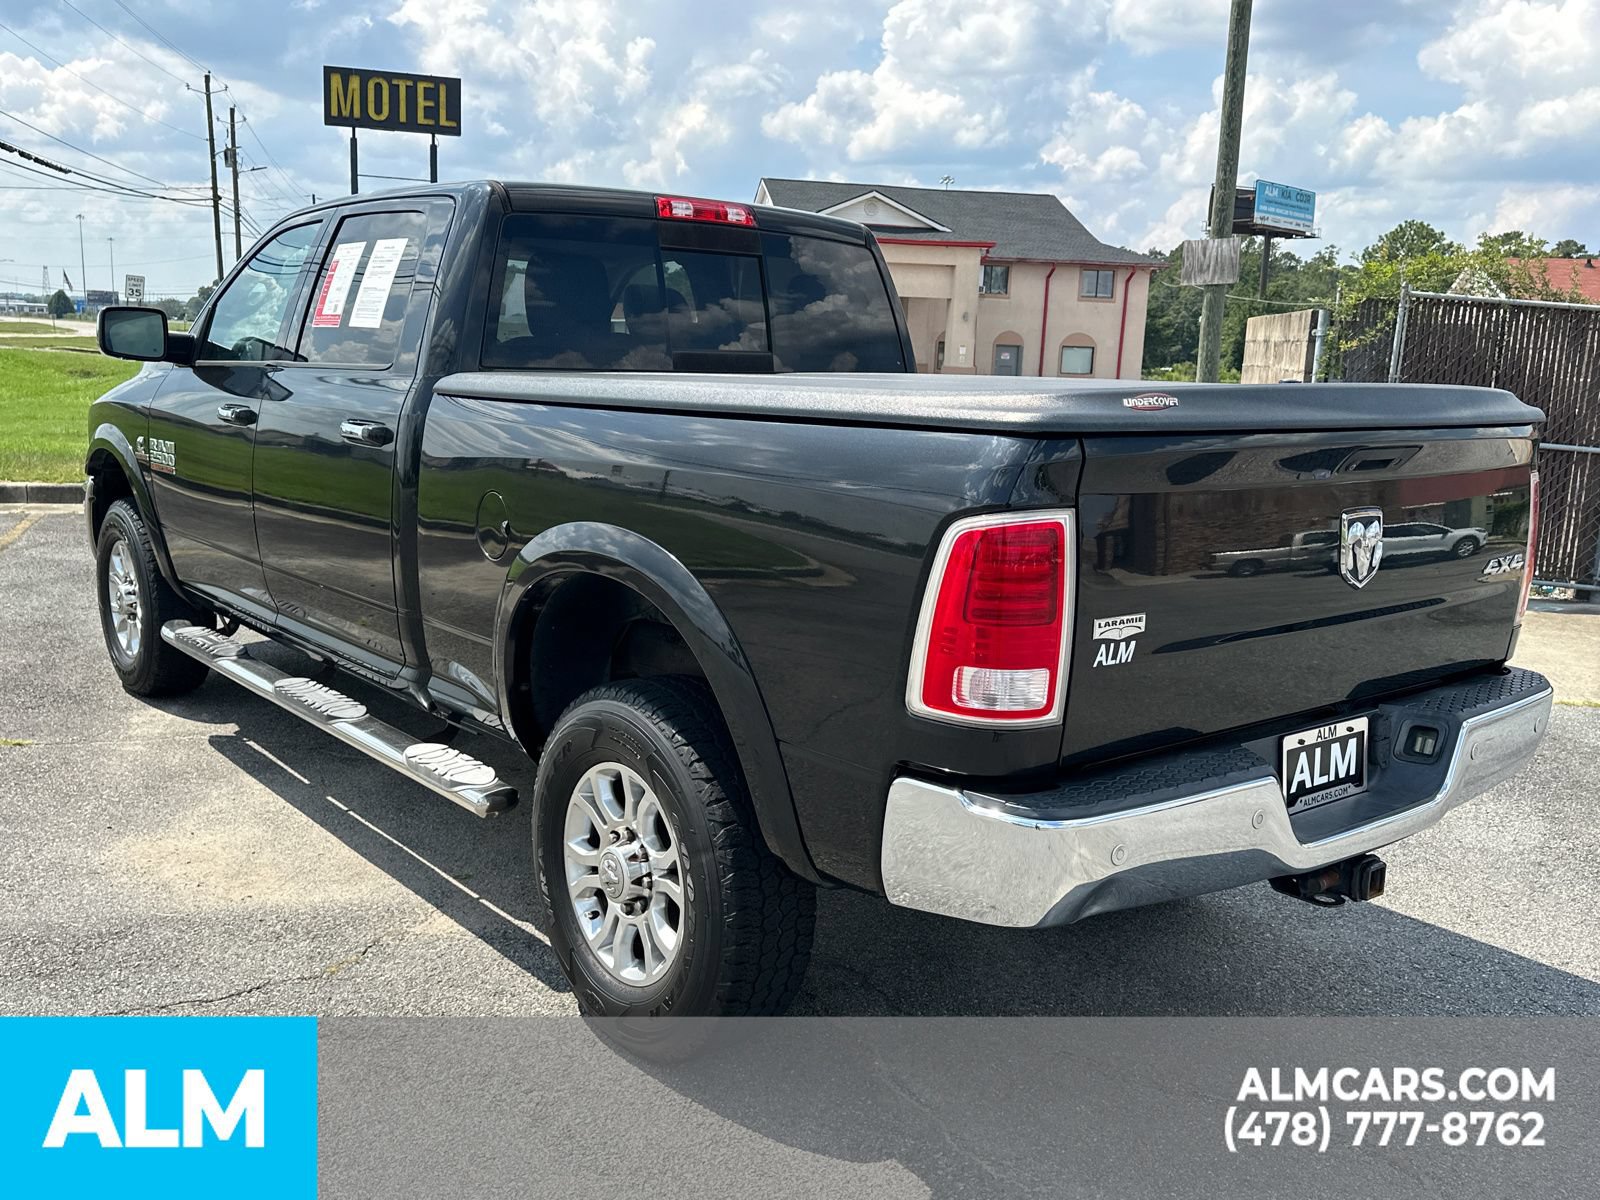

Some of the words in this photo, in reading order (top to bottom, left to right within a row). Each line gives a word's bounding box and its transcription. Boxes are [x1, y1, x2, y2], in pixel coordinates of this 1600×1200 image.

[330, 72, 457, 127] MOTEL
[1265, 185, 1279, 198] ALM
[1281, 189, 1292, 201] KIA
[128, 288, 142, 297] 35
[149, 437, 175, 453] RAM
[1097, 615, 1144, 629] LARAMIE
[1092, 640, 1137, 668] ALM
[1315, 724, 1338, 742] ALM
[1289, 737, 1358, 794] ALM
